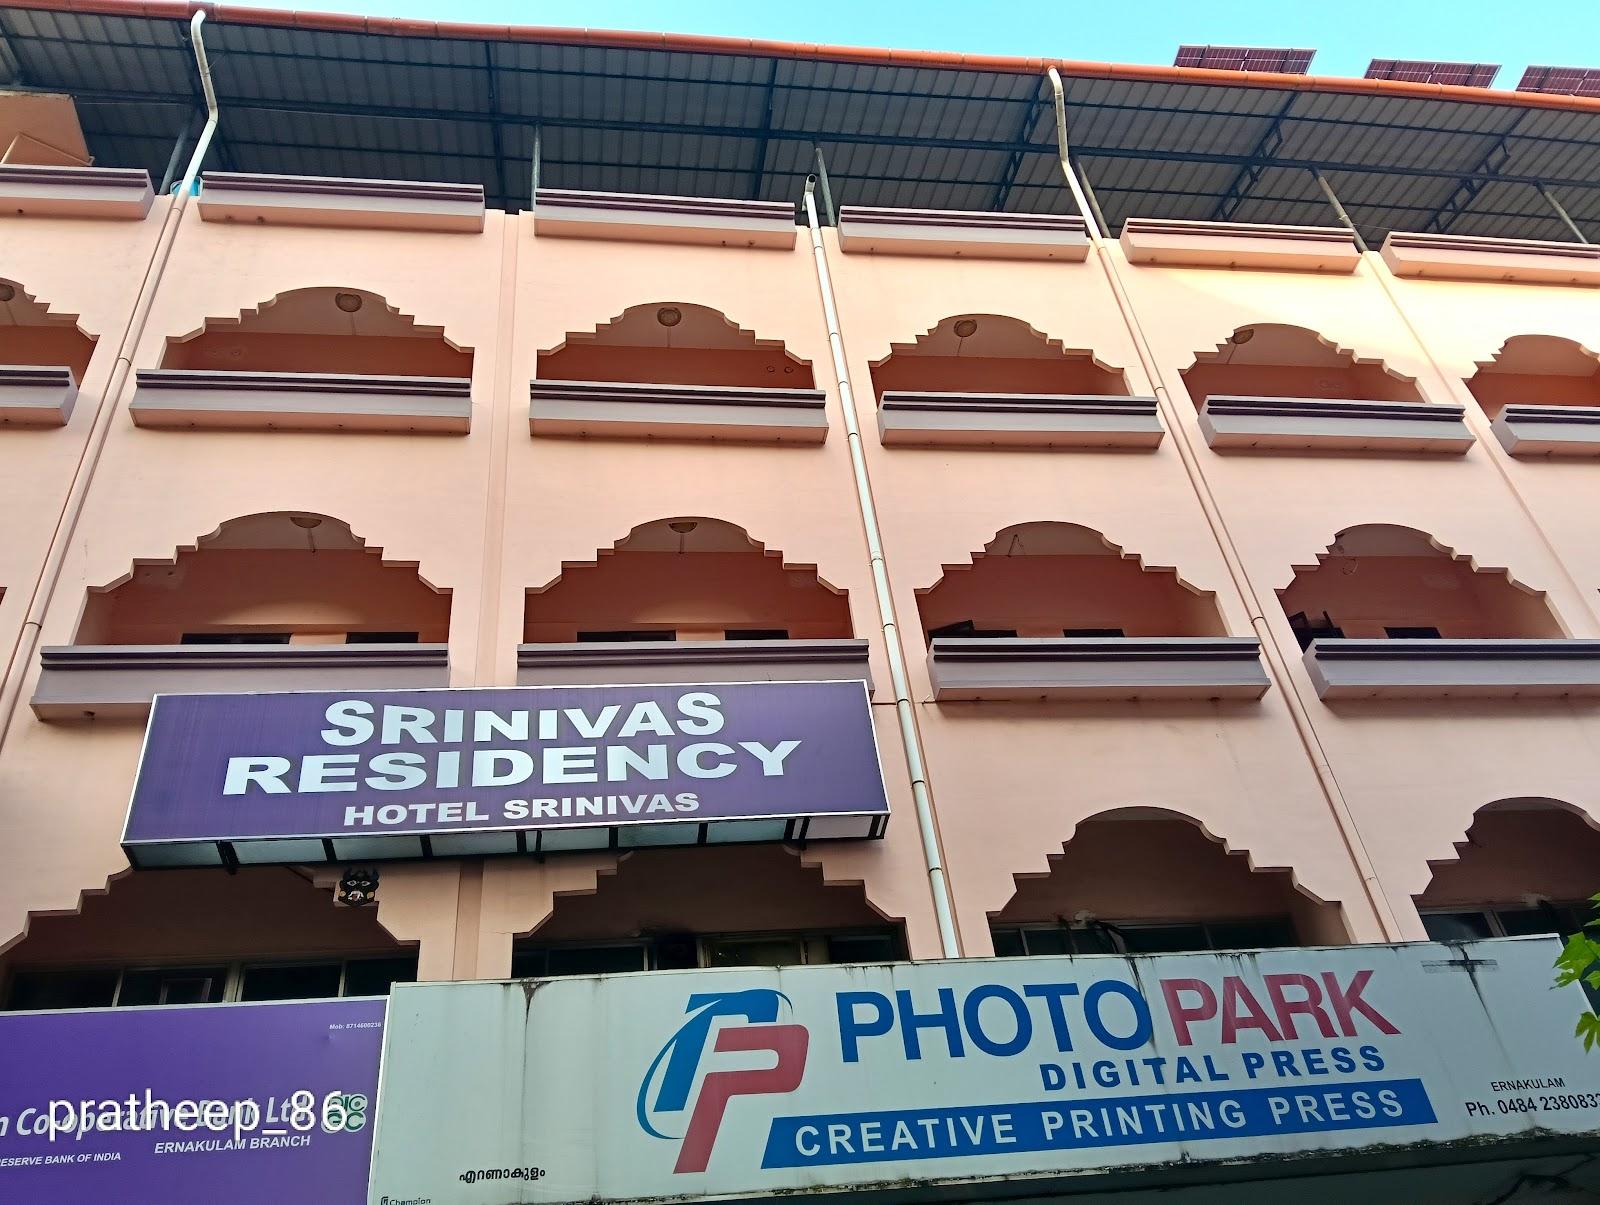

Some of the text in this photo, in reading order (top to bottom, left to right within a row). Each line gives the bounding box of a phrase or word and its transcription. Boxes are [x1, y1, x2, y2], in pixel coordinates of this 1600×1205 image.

[320, 692, 725, 746] SRINIVAS
[223, 739, 803, 795] RESIDENCY
[344, 792, 700, 827] HOTEL SRINIVAS
[836, 970, 1402, 1064] PHOTO PARK
[1040, 1045, 1385, 1092] DIGITAL PRESS
[1490, 1077, 1565, 1092] ERNAKULAM
[795, 1088, 1404, 1157] CREATIVE PRINTING PRESS
[1465, 1101, 1496, 1117] Ph.
[1497, 1096, 1538, 1115] 0484
[44, 1154, 75, 1165] BANK
[76, 1153, 92, 1163] OF
[93, 1152, 121, 1162] INDIA
[154, 1135, 311, 1154] ERNAKULAM BRANCH
[459, 1167, 546, 1184] എറണാകുളം
